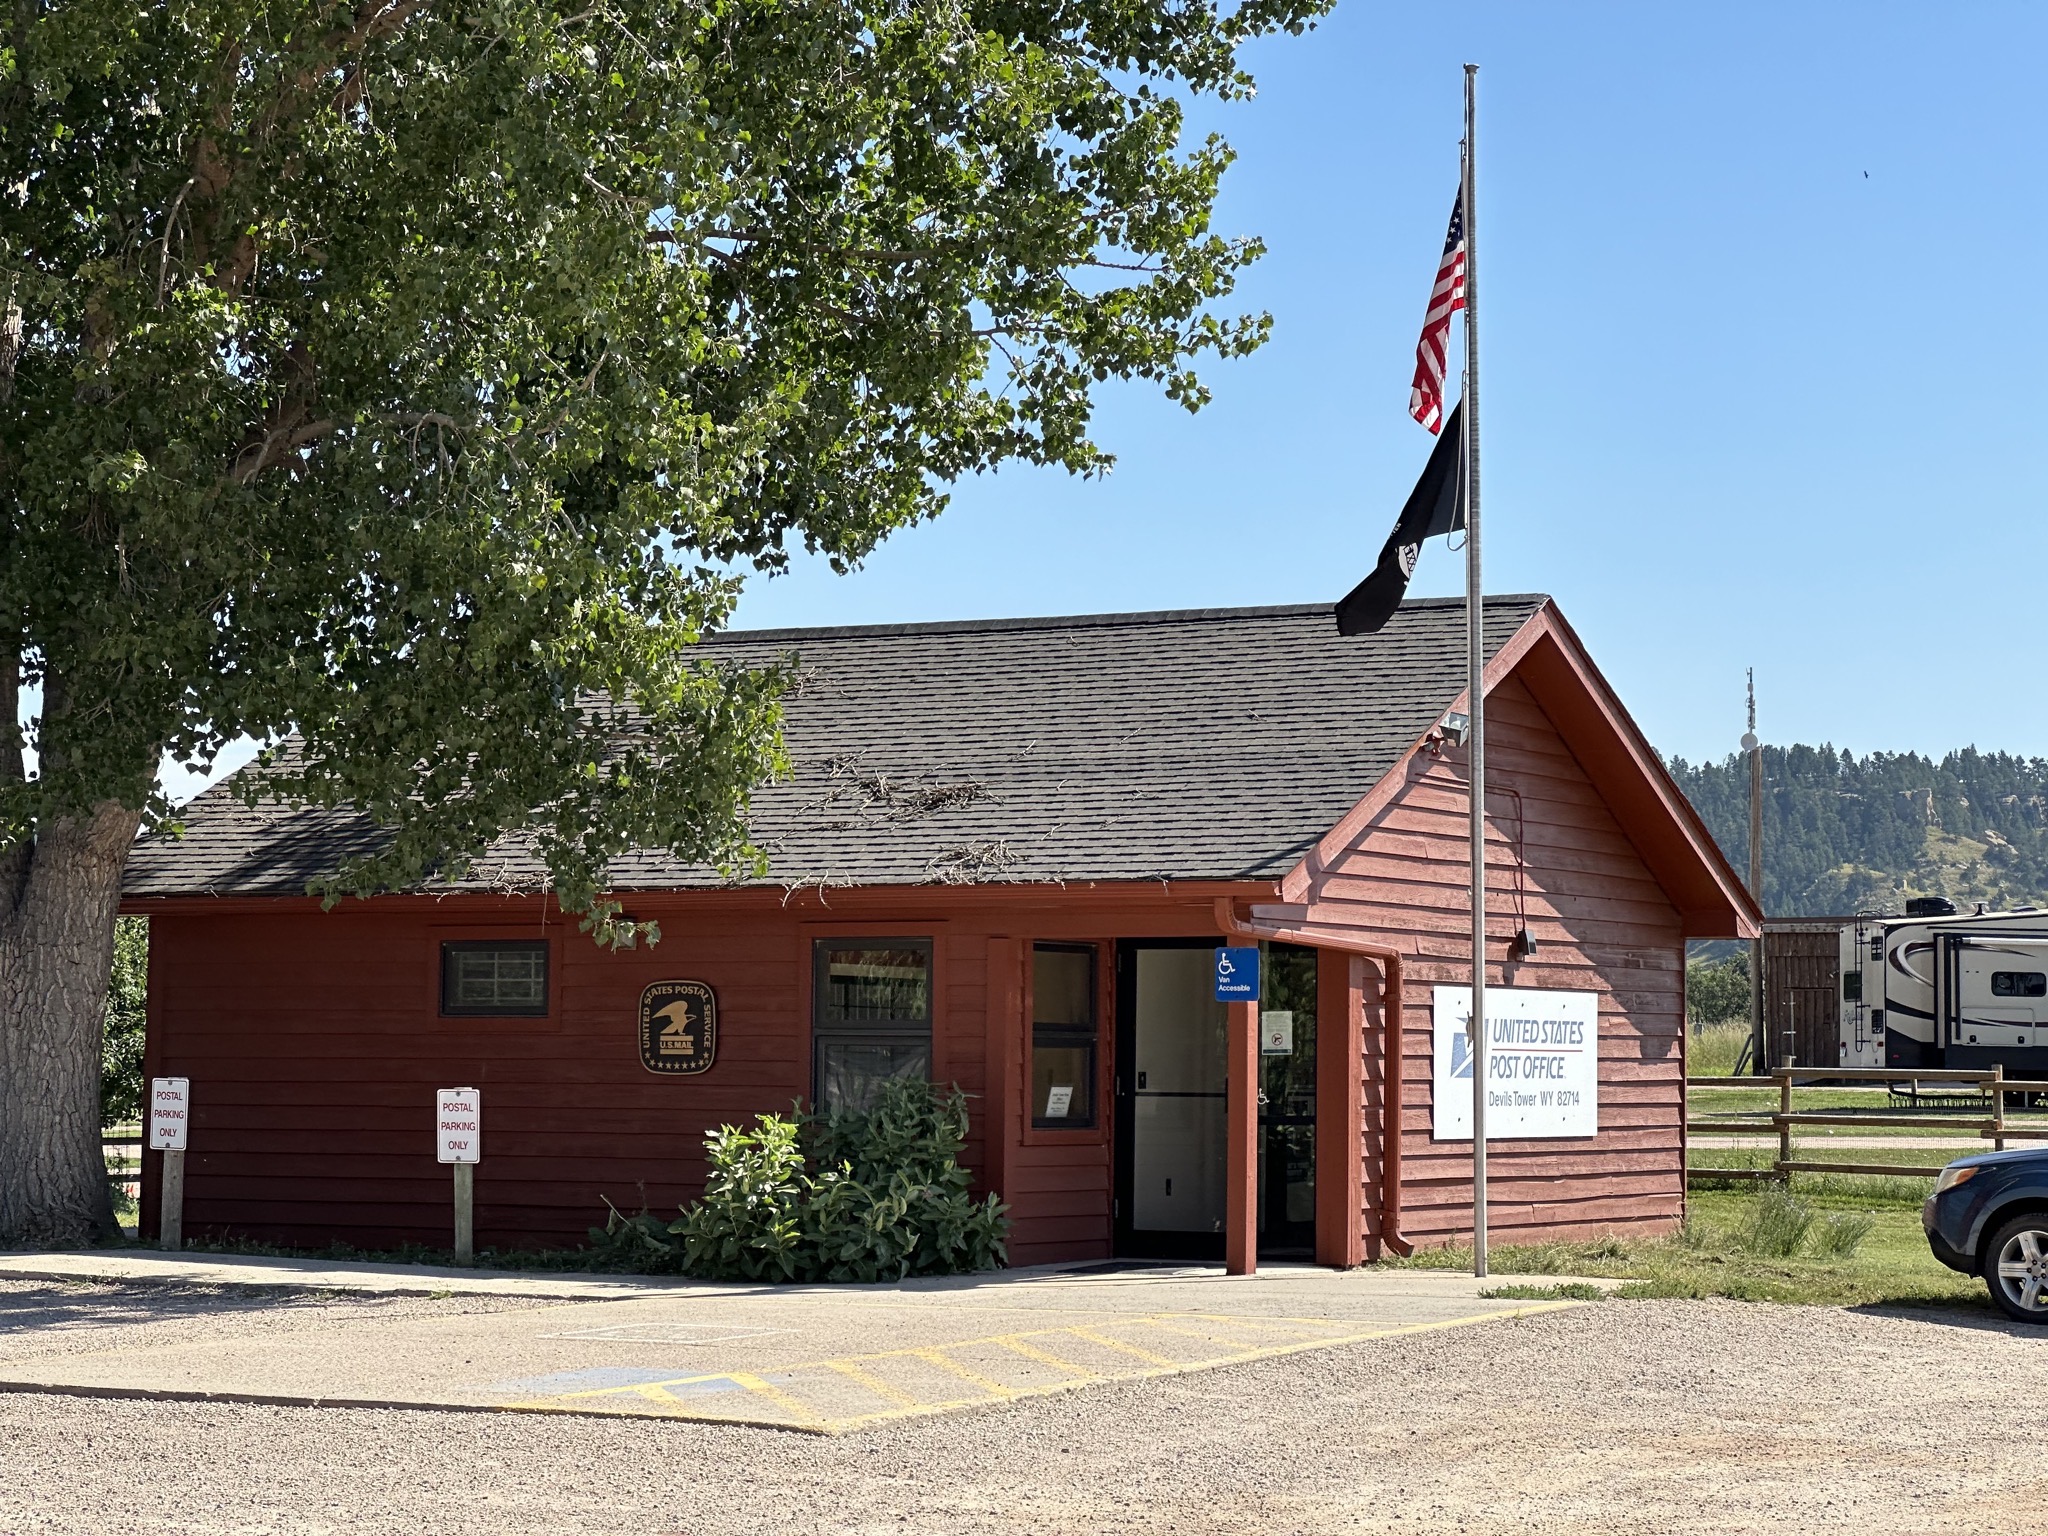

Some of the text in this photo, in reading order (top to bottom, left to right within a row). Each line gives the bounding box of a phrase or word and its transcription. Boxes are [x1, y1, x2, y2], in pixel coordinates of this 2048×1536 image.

[644, 986, 673, 1004] STATES
[675, 986, 709, 1003] POSTAL
[703, 1004, 711, 1048] SERVICE
[1493, 1018, 1584, 1044] UNITED STATES
[1489, 1055, 1565, 1079] POST OFFICE
[157, 1091, 183, 1101] POSTAL
[1489, 1090, 1580, 1107] Devils Tower WY 82714
[443, 1102, 473, 1112] POSTAL
[154, 1109, 184, 1119] PARKING
[441, 1121, 475, 1131] PARKING
[160, 1128, 177, 1137] ONLY
[448, 1140, 468, 1150] ONLY
